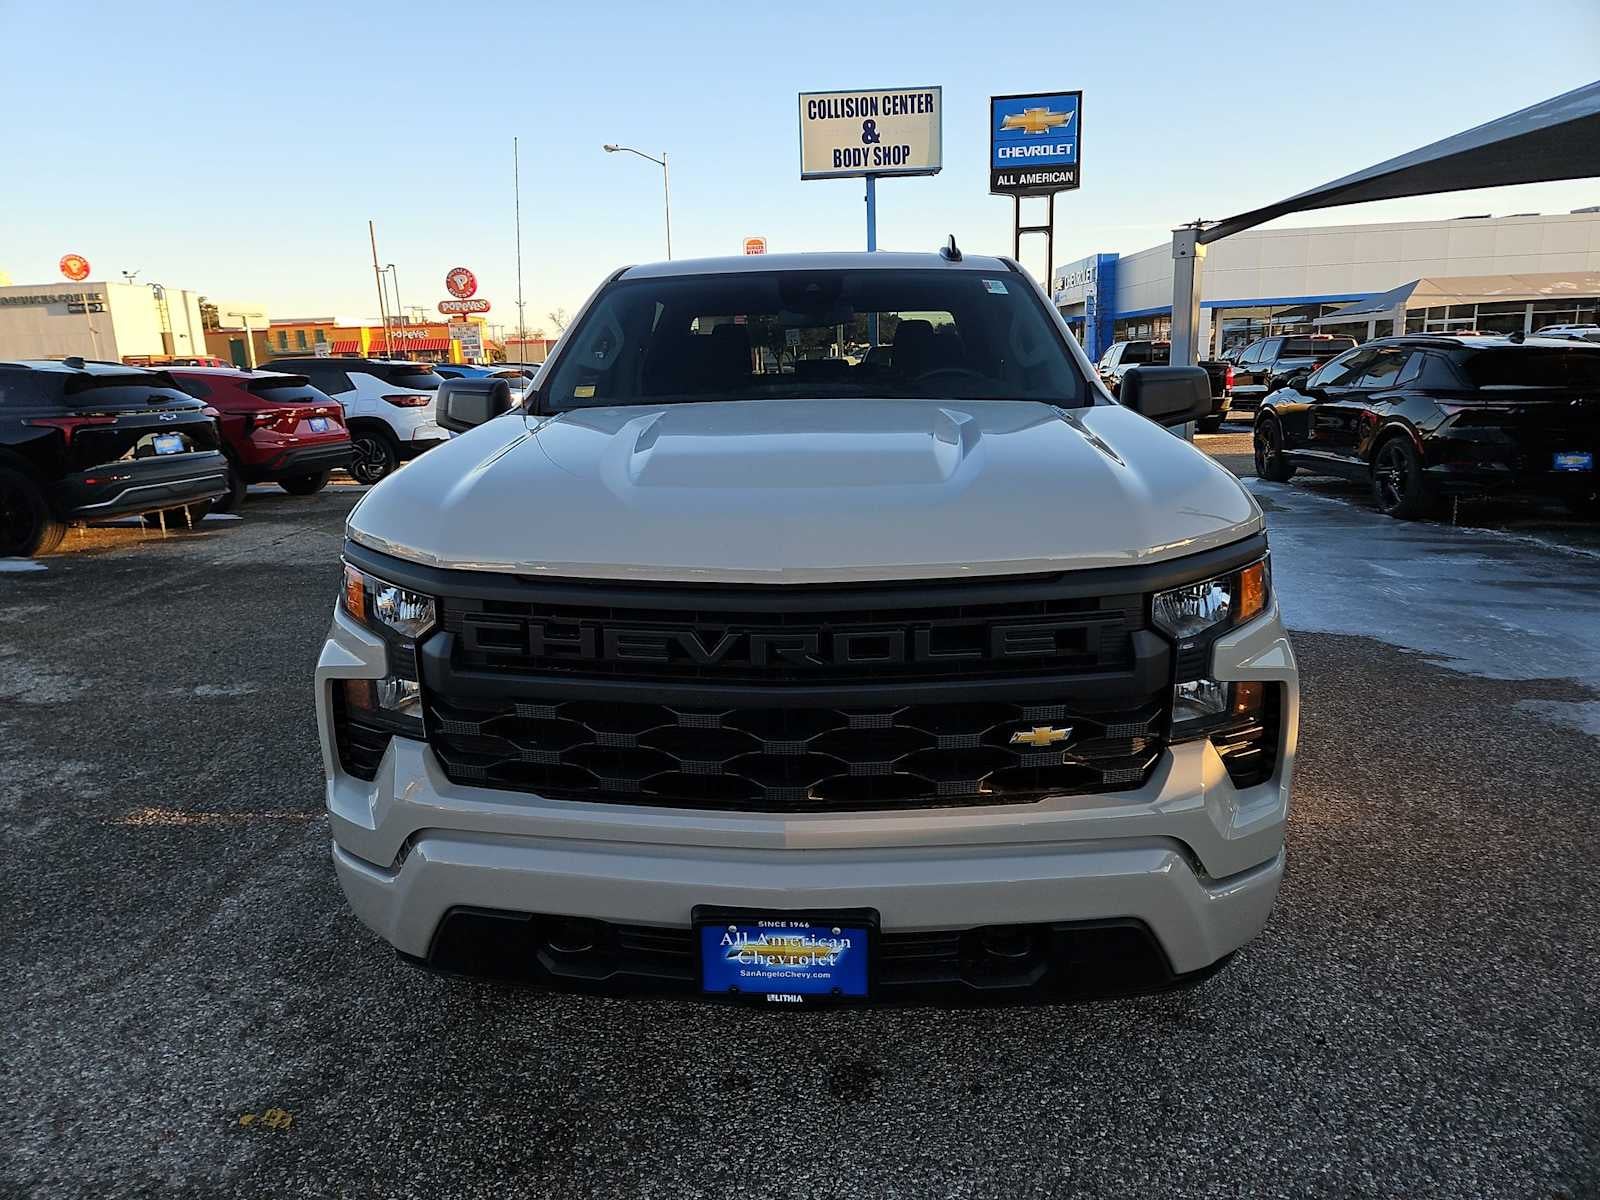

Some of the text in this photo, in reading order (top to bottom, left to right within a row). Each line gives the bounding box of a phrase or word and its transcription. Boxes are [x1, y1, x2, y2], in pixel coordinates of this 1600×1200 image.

[808, 93, 934, 120] COLLISION CENTER
[861, 119, 881, 145] &
[833, 145, 911, 168] BODY SHOP
[998, 144, 1073, 159] CHEVROLET
[997, 172, 1074, 186] ALL AMERICAN
[463, 609, 1127, 665] CHEVROLET
[720, 931, 852, 949] All American
[738, 948, 836, 967] Chevrolet
[740, 969, 831, 979] SanAngeloChevy.com
[776, 994, 804, 1003] LITHIA
